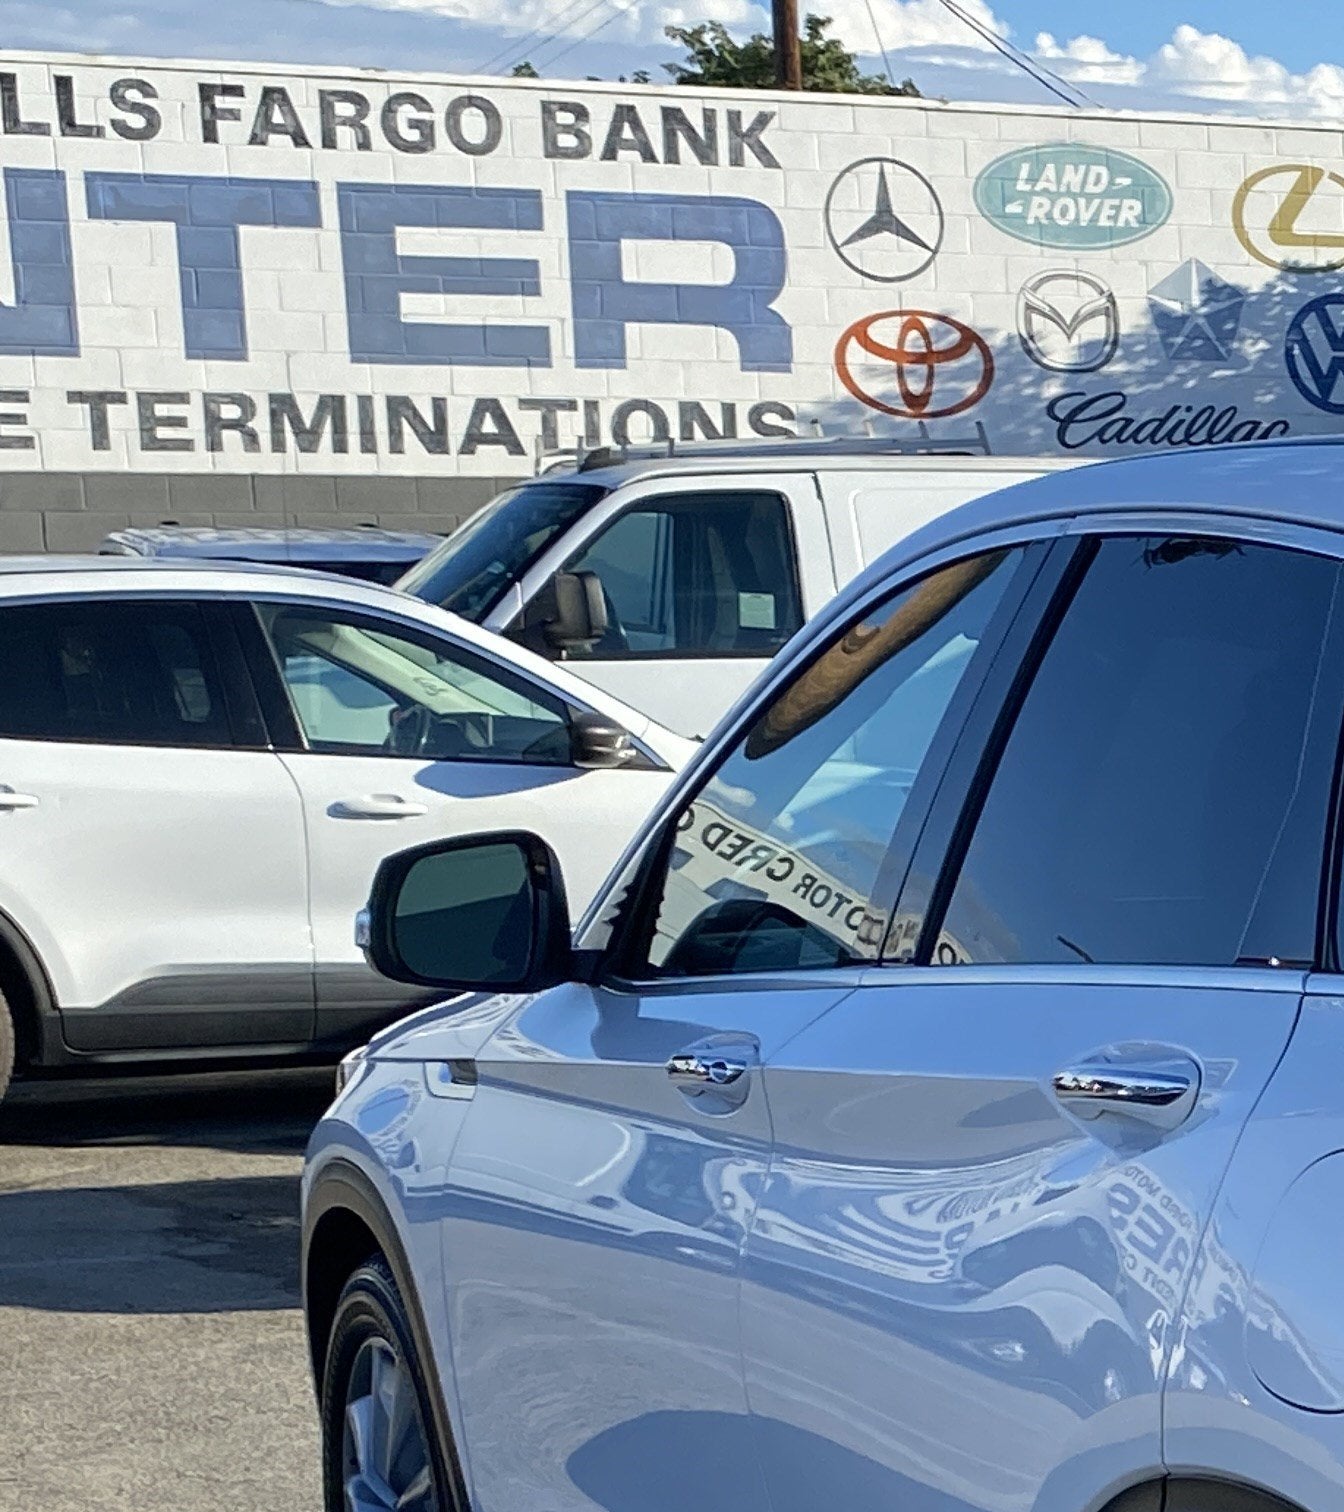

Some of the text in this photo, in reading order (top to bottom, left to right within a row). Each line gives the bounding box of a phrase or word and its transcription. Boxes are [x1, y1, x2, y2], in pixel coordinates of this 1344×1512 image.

[199, 82, 502, 155] FARGO
[541, 100, 781, 169] BANK
[66, 390, 798, 457] TERMINATIONS
[1046, 391, 1290, 449] Cadillac
